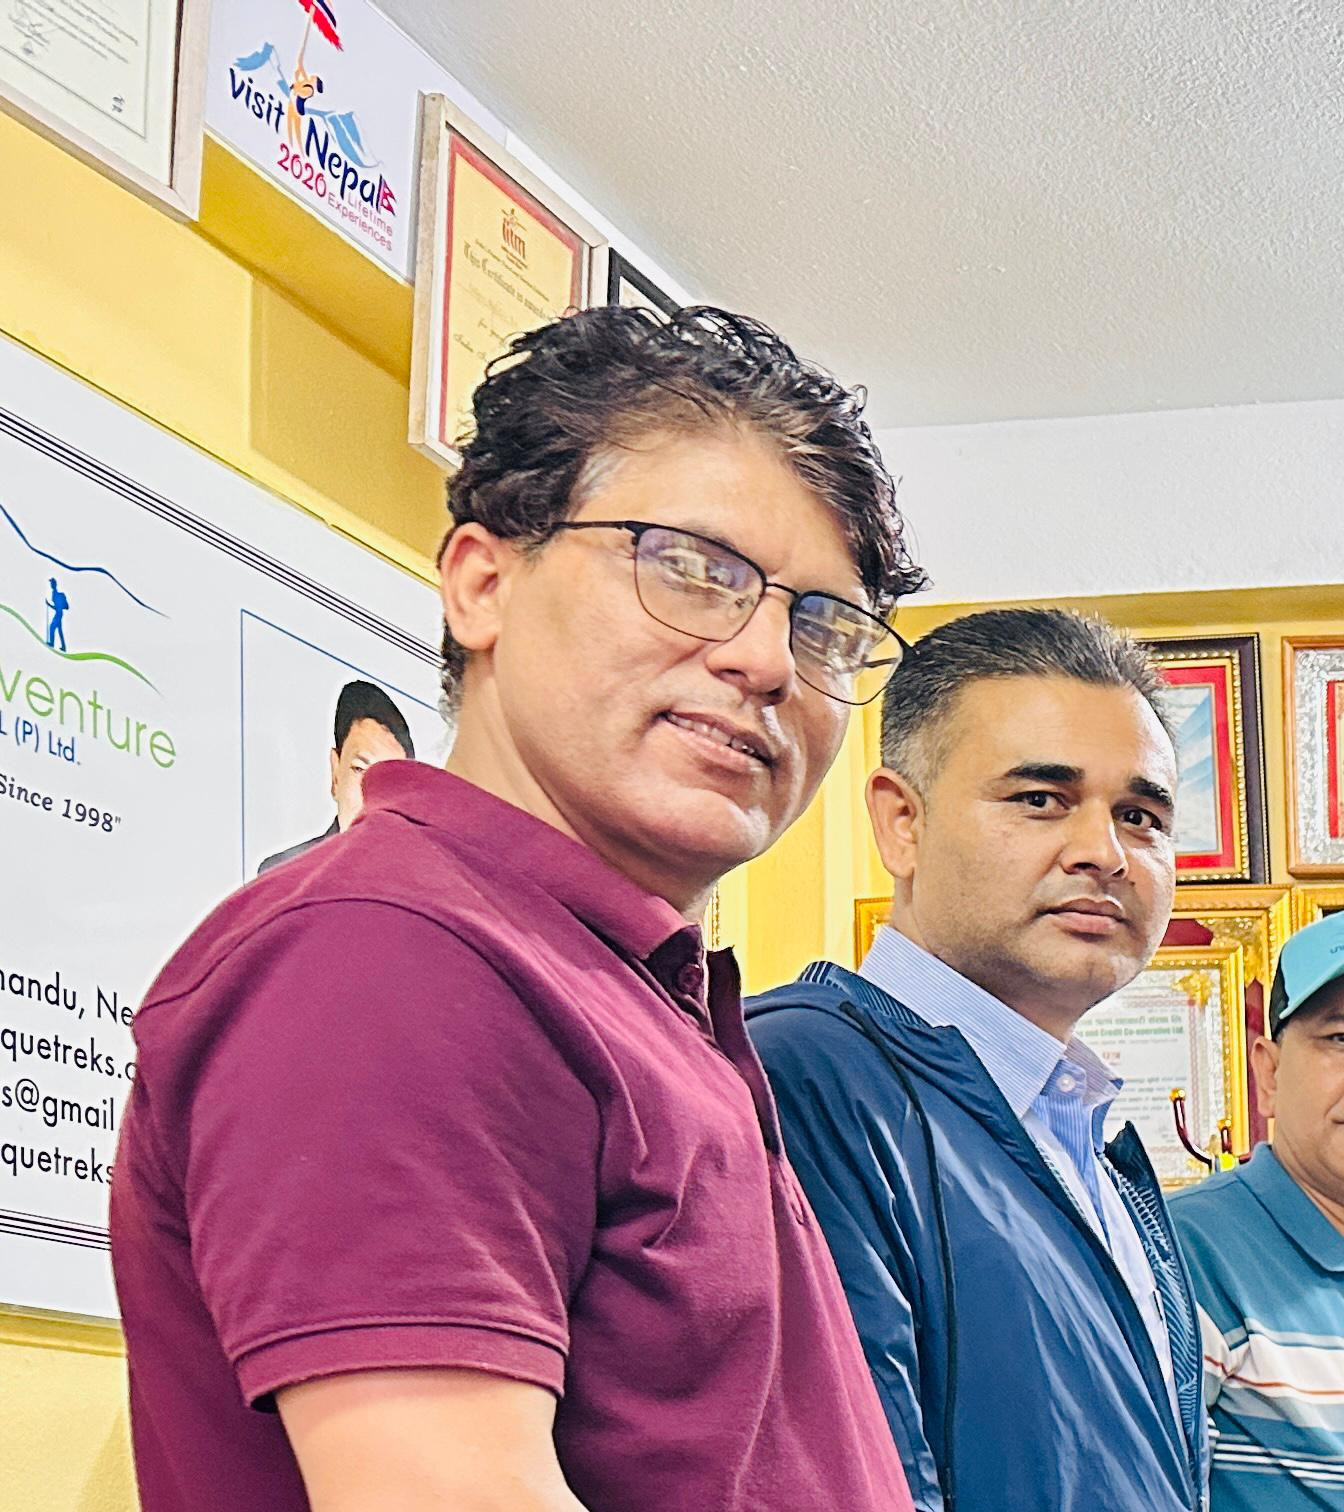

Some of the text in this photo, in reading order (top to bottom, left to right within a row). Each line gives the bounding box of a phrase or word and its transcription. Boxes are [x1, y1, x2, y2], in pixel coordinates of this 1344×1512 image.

[277, 143, 328, 198] 2020
[305, 117, 384, 214] Nepal
[327, 191, 393, 252] Experiences
[347, 192, 393, 238] Lifetime
[15, 716, 40, 753] (P)
[48, 730, 82, 766] Ltd.
[0, 968, 85, 1020] andu,
